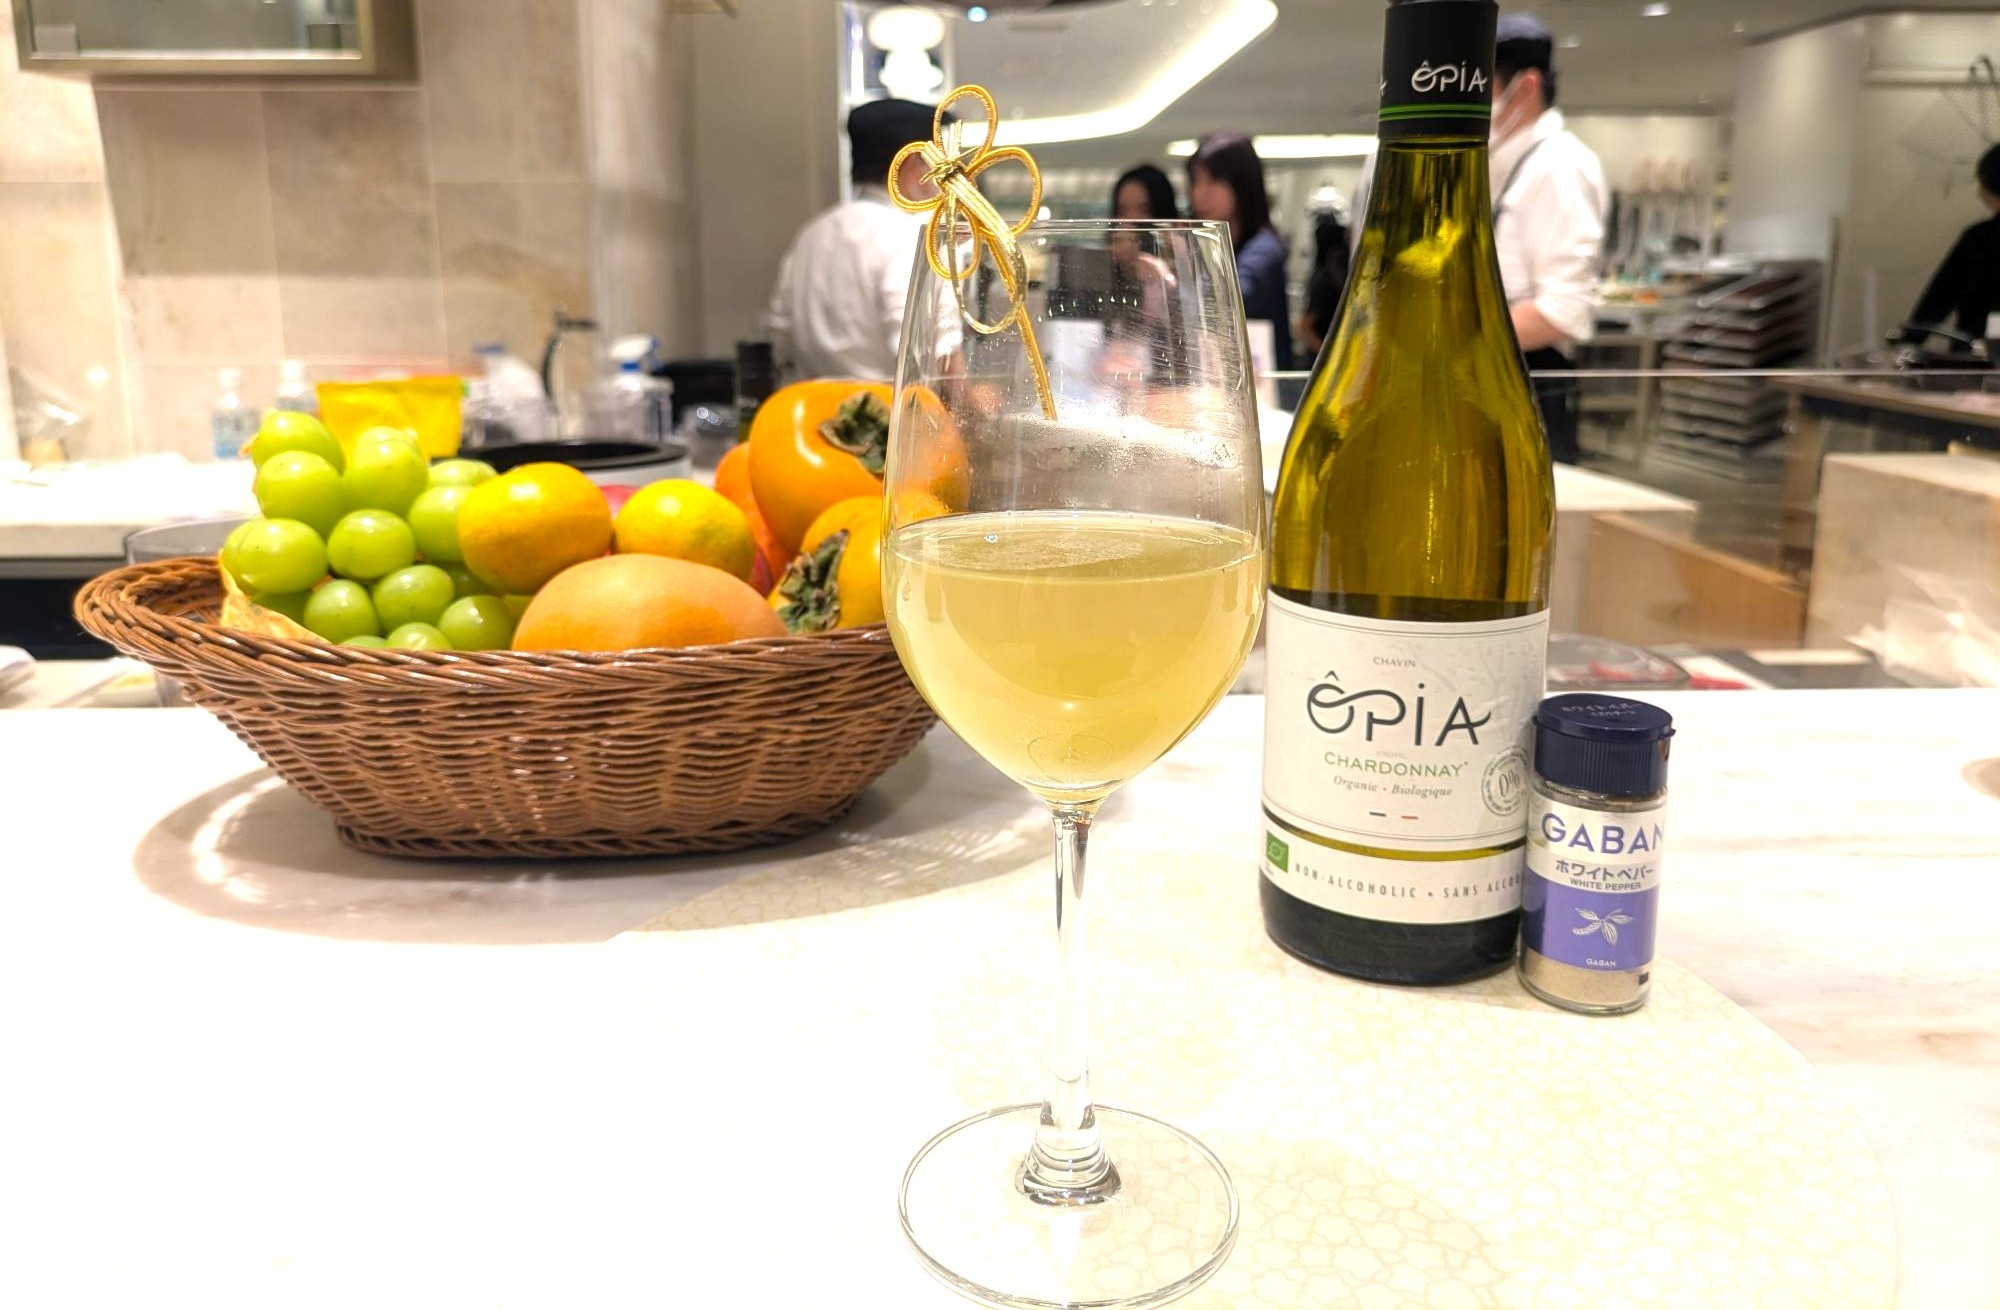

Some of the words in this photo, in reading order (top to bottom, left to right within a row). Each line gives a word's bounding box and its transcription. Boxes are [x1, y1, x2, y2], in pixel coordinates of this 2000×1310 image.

[1372, 656, 1416, 668] CHAVIN
[1324, 751, 1463, 778] CHARDONNAY
[1333, 775, 1378, 791] Organic
[1391, 784, 1453, 799] Biologique
[1541, 812, 1664, 855] GABAN
[1443, 884, 1478, 898] SANS
[1569, 877, 1603, 890] WHITE
[1604, 881, 1642, 892] PEPPER
[1585, 957, 1617, 968] GABAN
